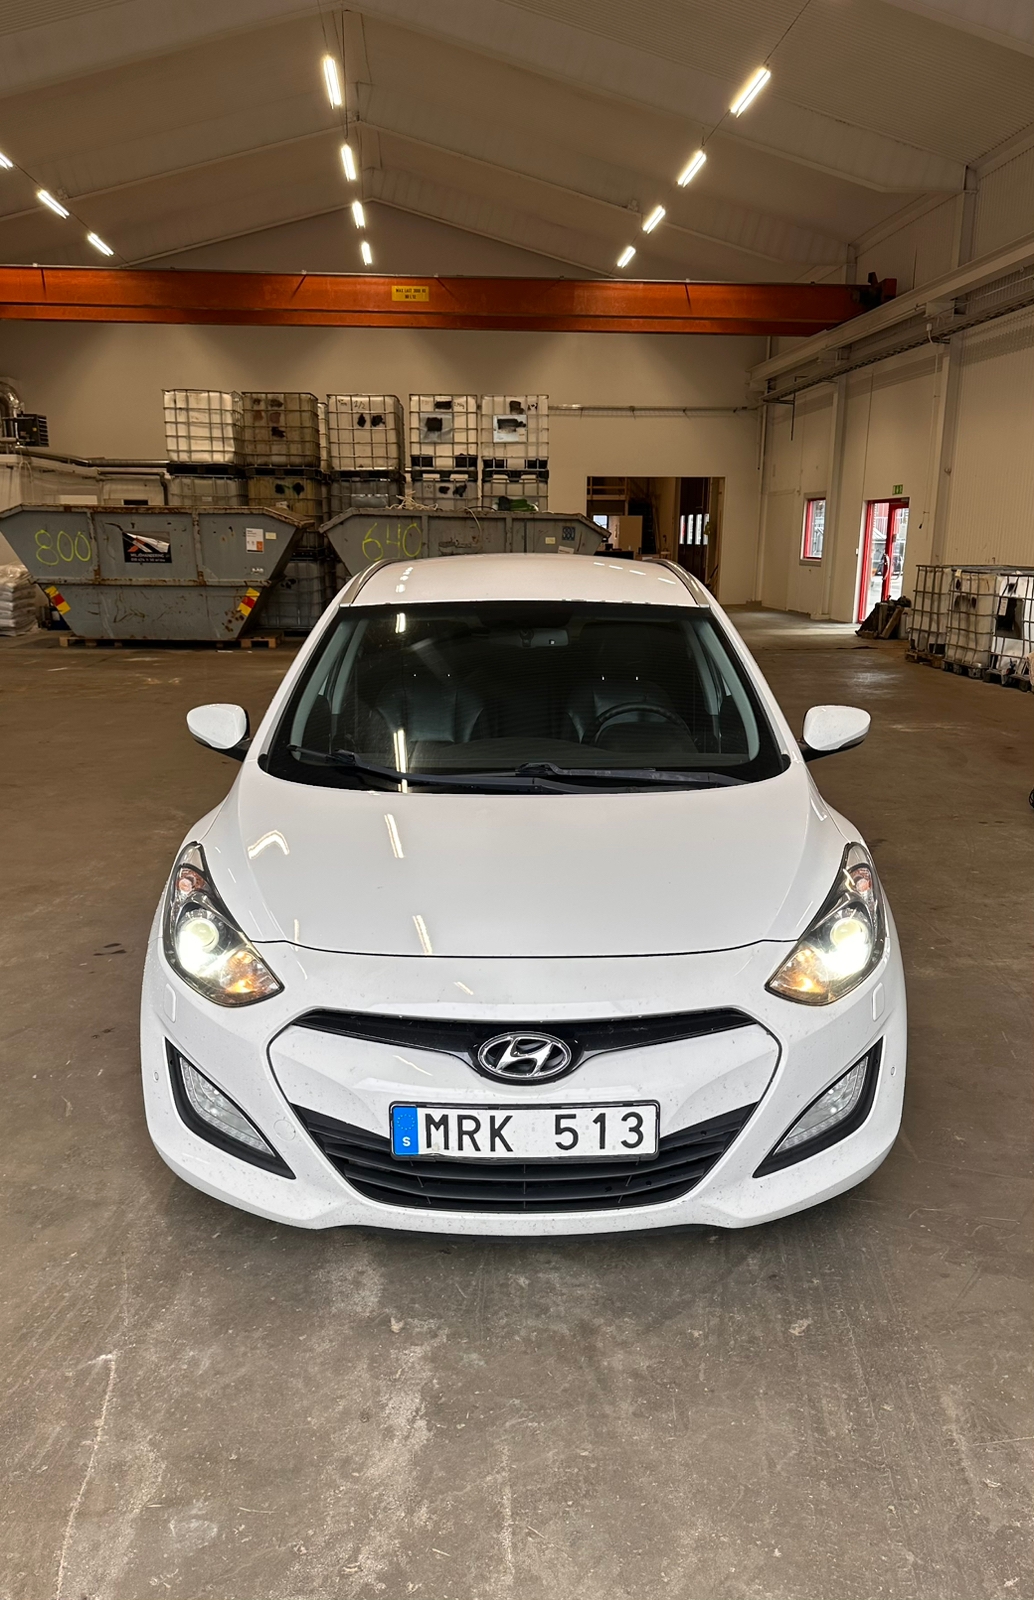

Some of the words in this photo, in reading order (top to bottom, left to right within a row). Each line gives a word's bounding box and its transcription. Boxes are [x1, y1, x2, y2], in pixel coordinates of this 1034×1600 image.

[35, 529, 91, 566] 800
[362, 522, 422, 562] 640
[402, 1136, 411, 1147] S
[425, 1113, 513, 1152] MRK
[555, 1111, 644, 1151] 513
